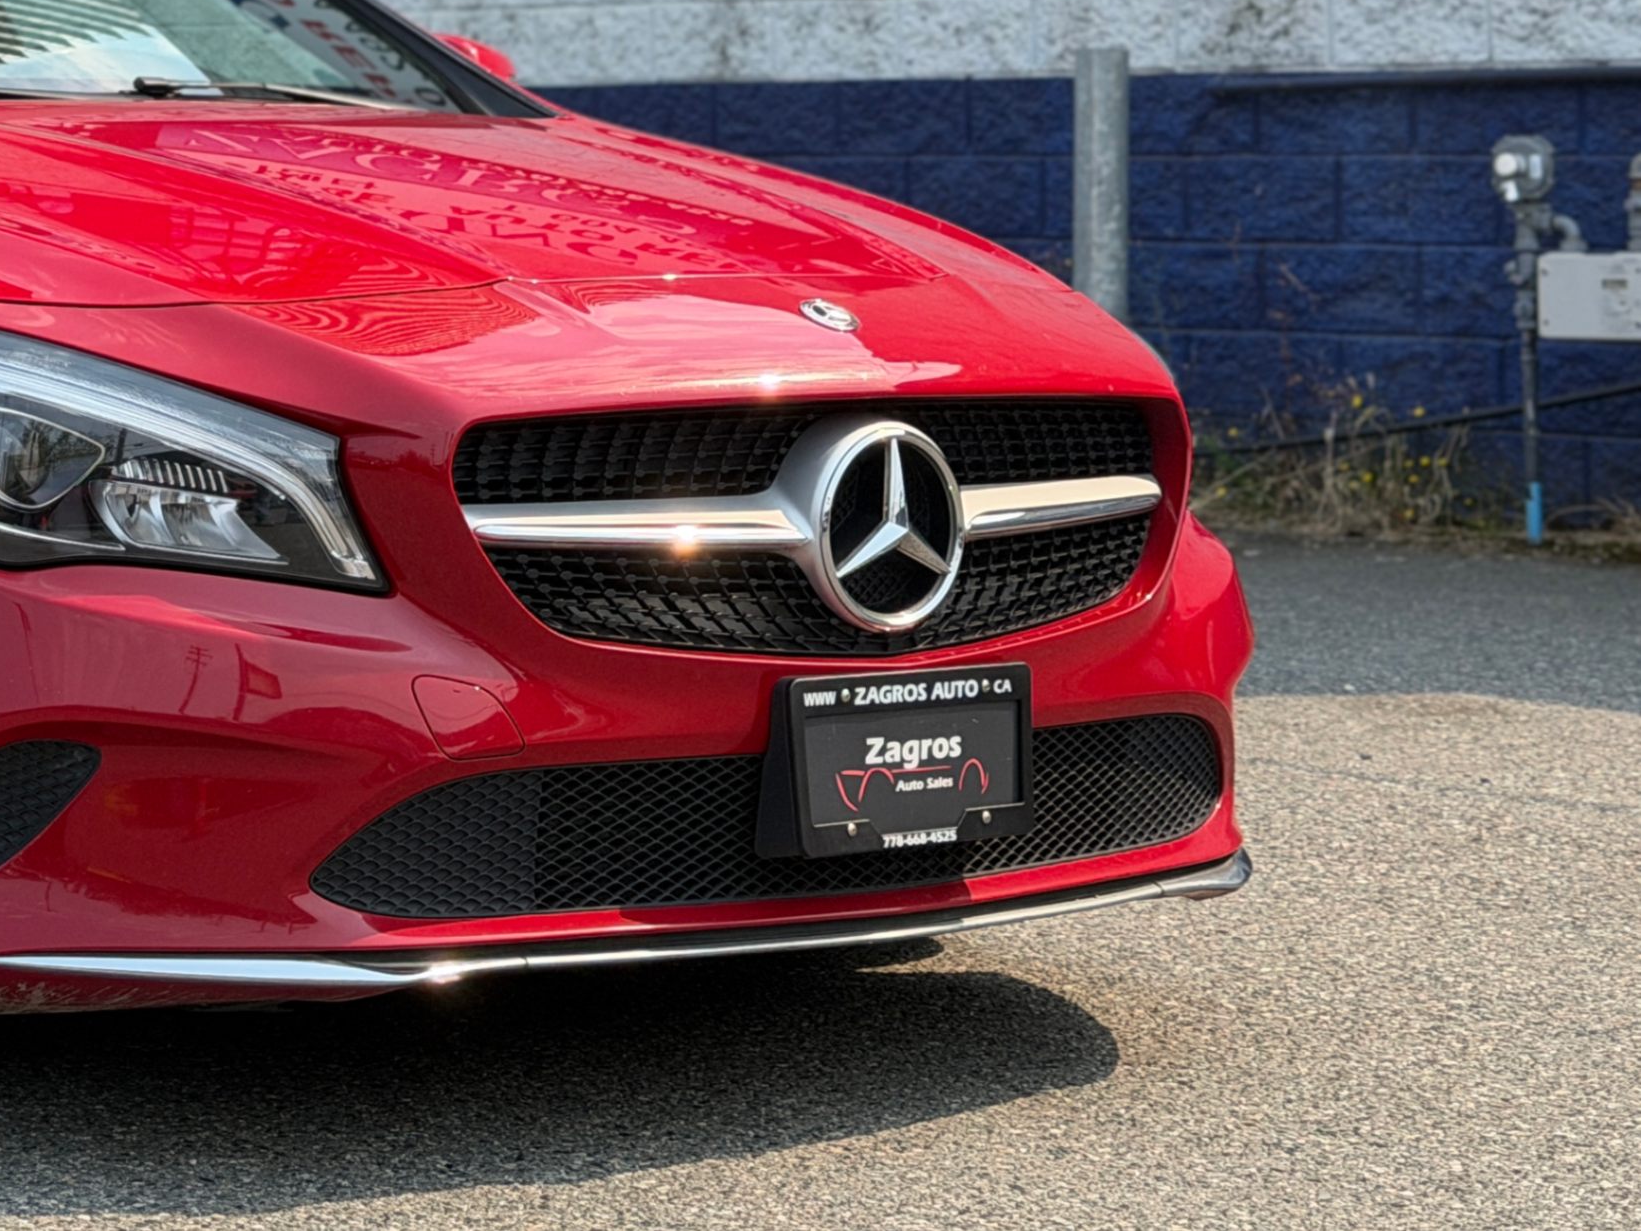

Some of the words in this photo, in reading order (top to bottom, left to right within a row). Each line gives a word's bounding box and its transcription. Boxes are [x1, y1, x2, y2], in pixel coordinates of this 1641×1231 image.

[803, 691, 837, 707] WWW
[854, 683, 928, 706] ZAGROS
[930, 679, 978, 700] AUTO
[993, 679, 1012, 694] CA
[865, 735, 962, 769] Zagros
[895, 779, 924, 792] Auto
[926, 776, 954, 790] Sales
